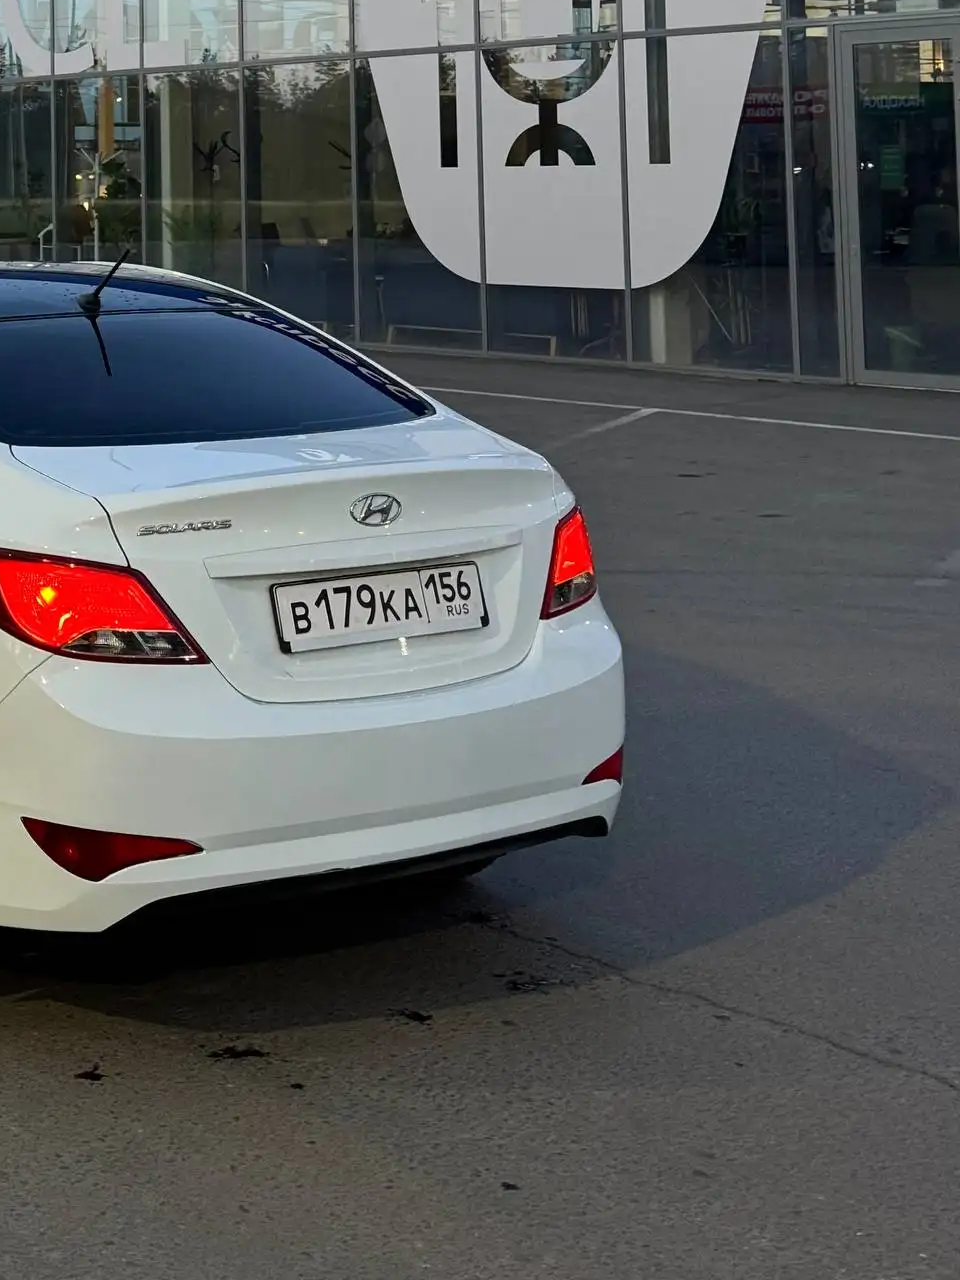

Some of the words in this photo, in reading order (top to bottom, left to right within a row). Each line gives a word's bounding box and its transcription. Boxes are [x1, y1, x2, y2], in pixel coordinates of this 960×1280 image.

[290, 583, 423, 635] В179КА
[424, 570, 471, 605] 156
[446, 603, 470, 617] RUS
